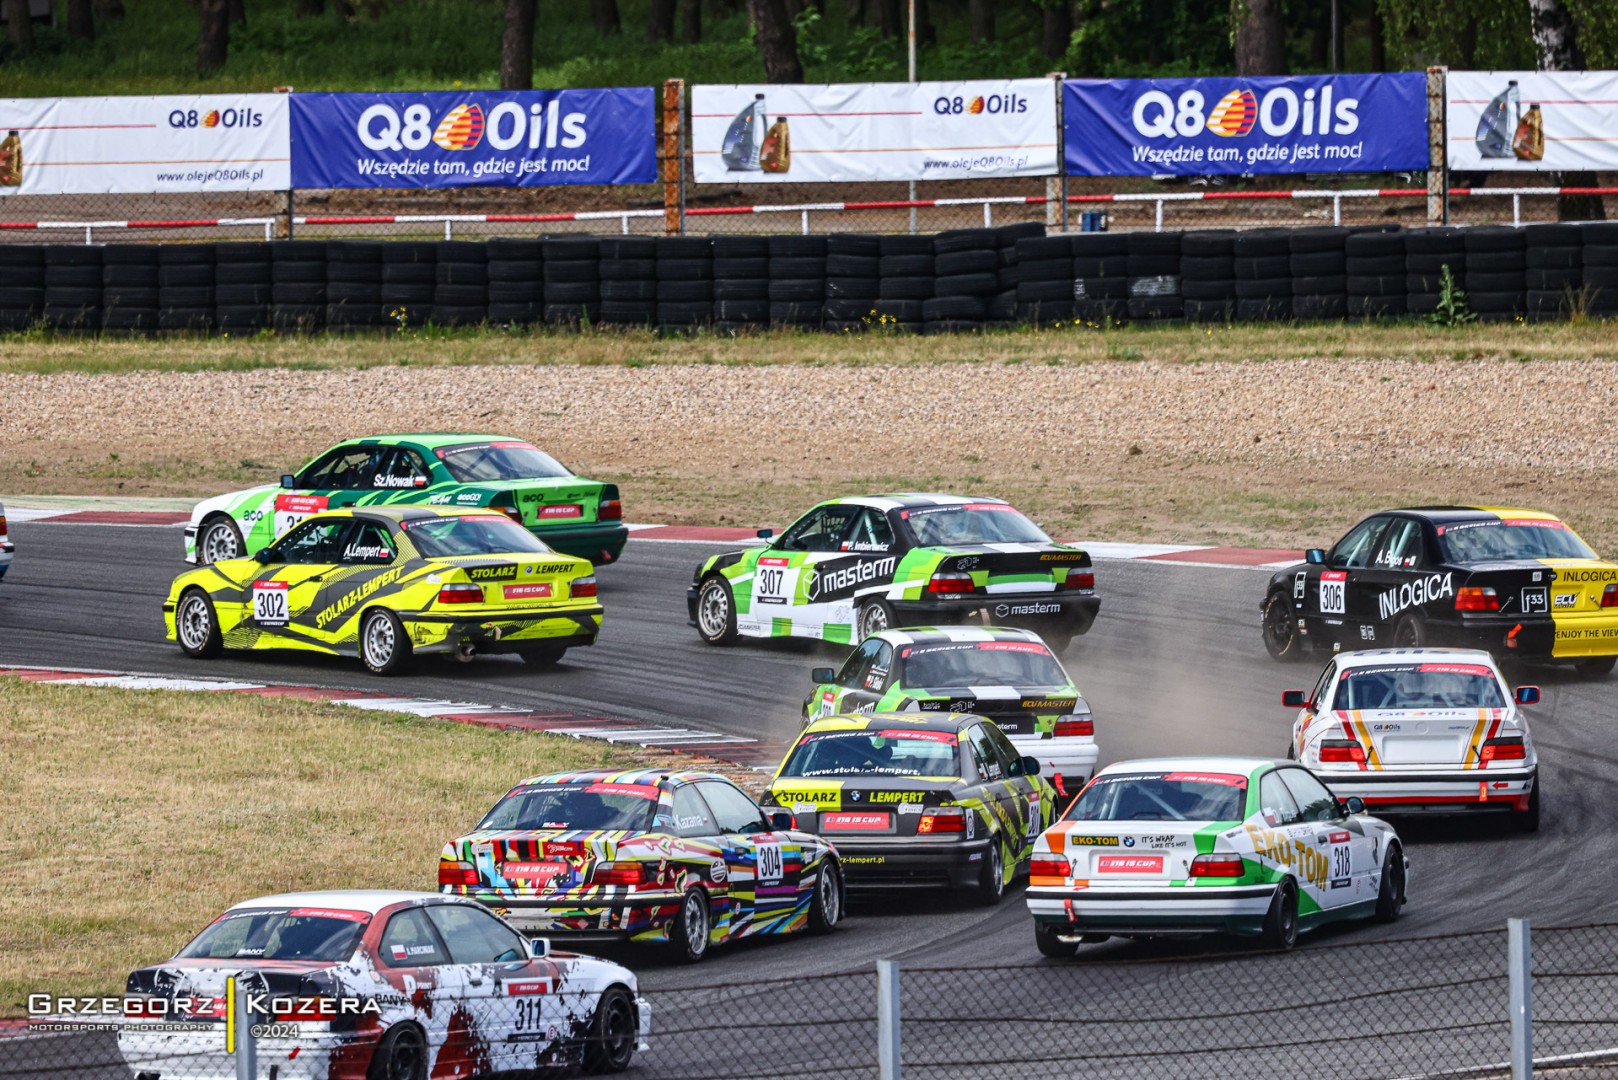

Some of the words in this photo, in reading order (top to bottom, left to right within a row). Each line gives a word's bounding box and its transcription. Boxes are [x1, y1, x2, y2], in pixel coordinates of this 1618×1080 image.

[934, 96, 964, 115] Q8
[986, 93, 1028, 114] Oils
[1131, 89, 1206, 139] Q8
[1259, 84, 1359, 137] Oils
[168, 109, 199, 129] Q8
[221, 107, 263, 129] Oils
[356, 103, 432, 151] Q8
[486, 99, 587, 151] Oils
[923, 155, 1028, 171] www.olejeQ8Oils.pl
[1132, 145, 1204, 167] Wszędzie
[1206, 145, 1243, 164] tam,
[1246, 144, 1289, 165] gdzie
[1291, 144, 1321, 165] jest
[1324, 142, 1363, 160] moc!
[156, 168, 264, 183] www.olejeQ8Oils.pl
[356, 157, 430, 180] Wszędzie
[433, 157, 470, 177] tam,
[472, 156, 516, 178] gdzie
[516, 157, 548, 178] jest
[550, 155, 590, 173] moc!
[373, 474, 415, 488] Sz.Nowak
[522, 493, 545, 503] aco
[243, 510, 264, 522] aco
[471, 566, 516, 580] STOLARZ
[536, 563, 576, 575] LEMPERT
[760, 569, 784, 595] 307
[823, 557, 896, 593] masterm
[1563, 571, 1617, 582] INLOGICA
[257, 592, 285, 618] 302
[315, 565, 406, 630] STOLARZ-LEMPERT
[1322, 584, 1342, 611] 306
[1378, 572, 1454, 620] INLOGICA
[1554, 594, 1578, 605] ECU
[1011, 602, 1061, 615] masterm
[1556, 629, 1582, 639] ENJOY
[1583, 629, 1599, 638] THE
[1021, 700, 1076, 708] ECUMASTER
[782, 791, 837, 803] STOLARZ
[869, 791, 926, 803] LEMPERT
[673, 813, 704, 831] Kazana
[1071, 835, 1119, 846] EKO-TOM
[1155, 835, 1175, 843] WRAP
[759, 847, 782, 878] 304
[1244, 823, 1329, 892] EKO-TOM
[1334, 846, 1351, 878] 318
[514, 998, 542, 1031] 311
